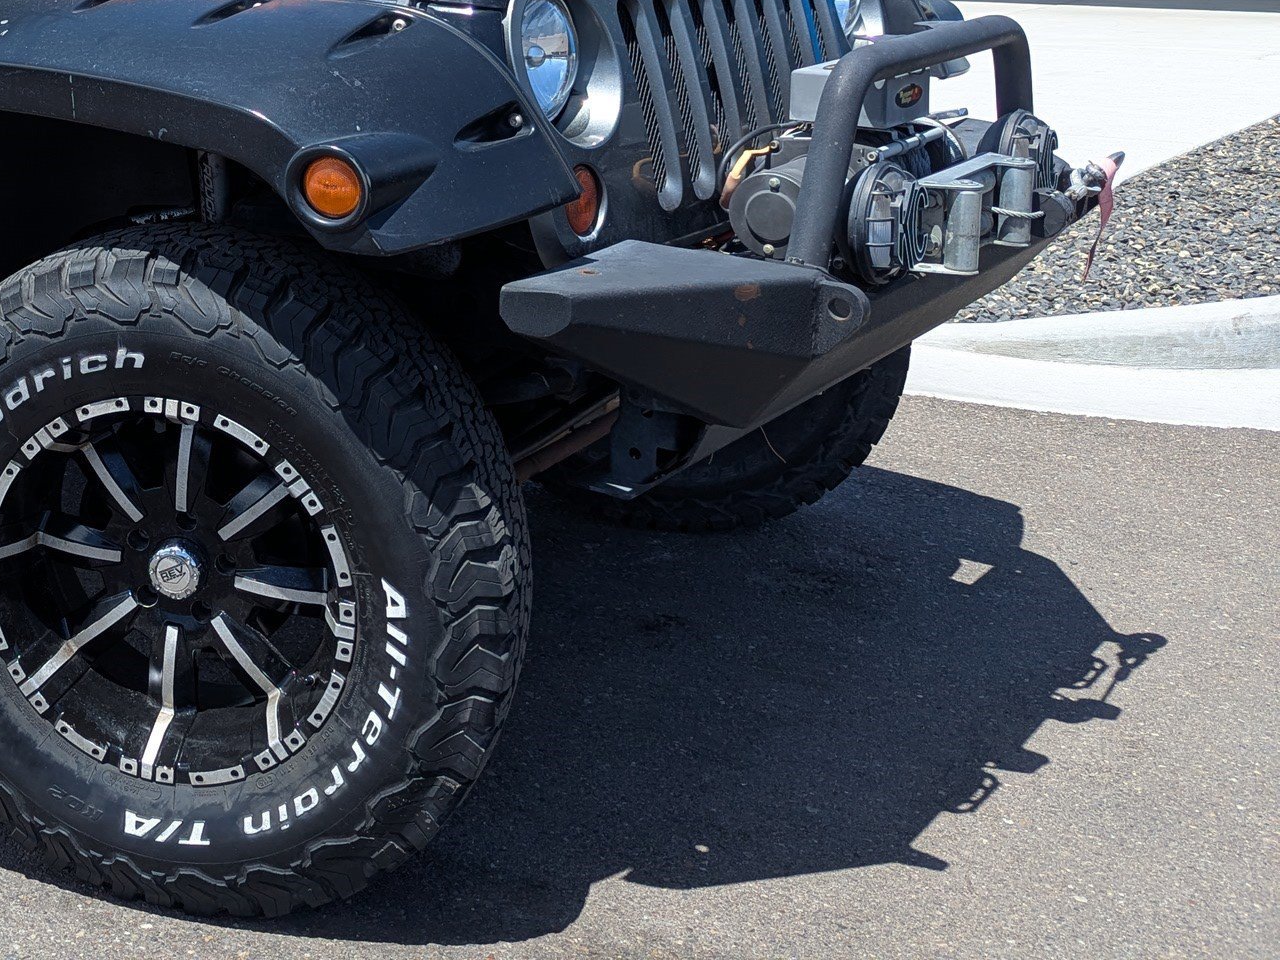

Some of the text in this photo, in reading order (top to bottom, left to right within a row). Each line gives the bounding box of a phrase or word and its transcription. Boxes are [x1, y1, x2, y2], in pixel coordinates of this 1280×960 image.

[898, 180, 929, 271] KC
[160, 565, 184, 583] REV
[243, 577, 408, 836] All-Terrain
[124, 810, 212, 846] T/A
